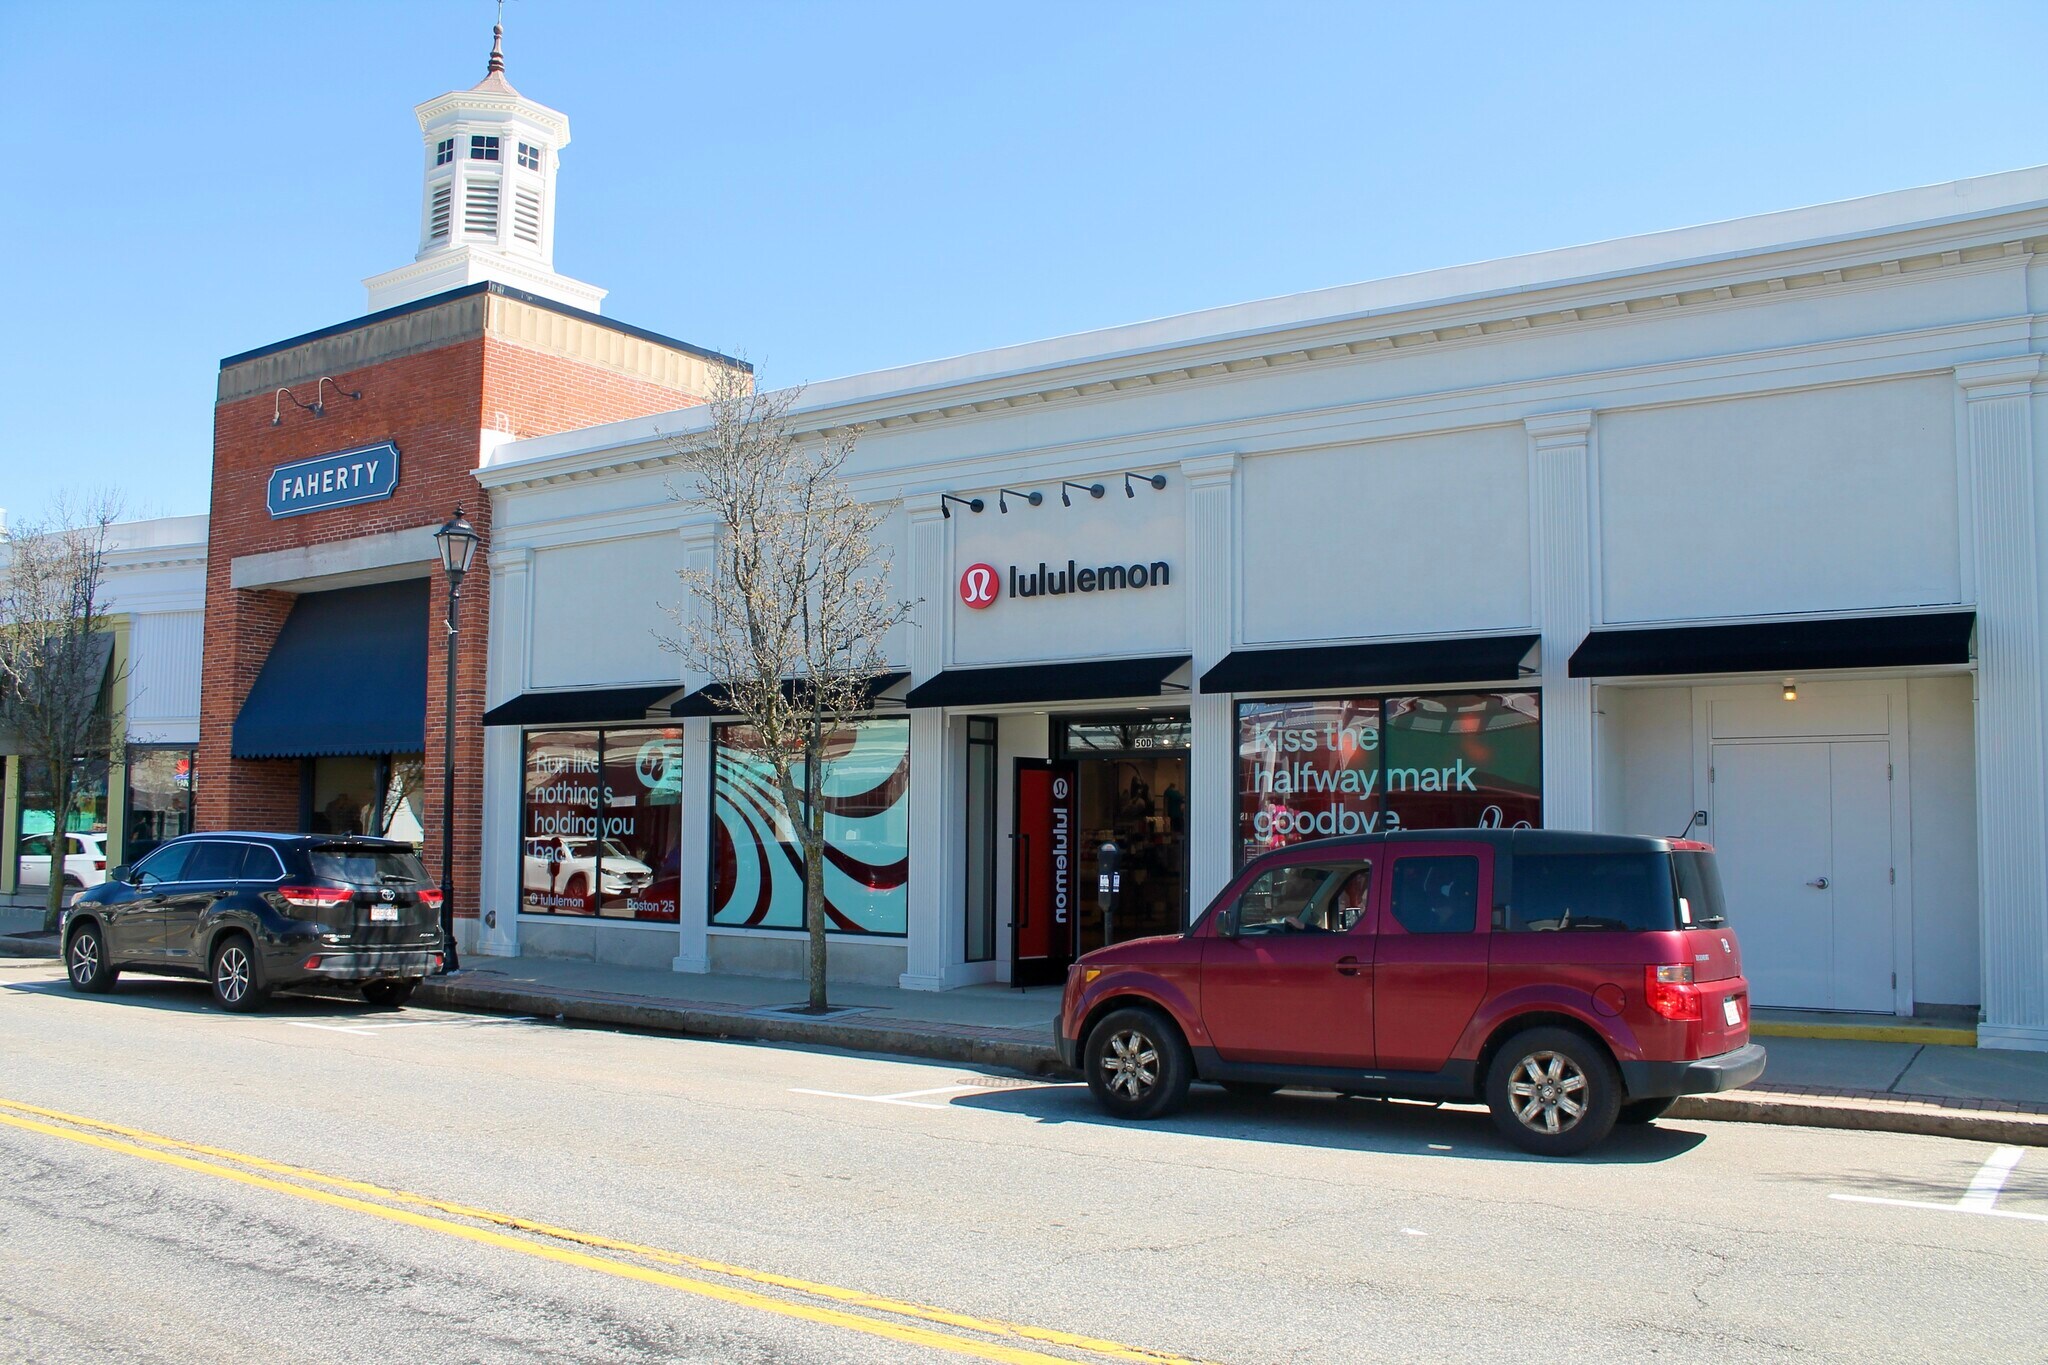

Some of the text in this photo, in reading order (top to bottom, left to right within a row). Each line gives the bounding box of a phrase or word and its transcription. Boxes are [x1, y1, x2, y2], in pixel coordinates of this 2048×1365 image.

[282, 460, 379, 501] FAHERTY
[1009, 559, 1170, 598] lululemon
[1255, 720, 1379, 752] Kiss the
[536, 749, 599, 774] Run like
[1254, 758, 1477, 800] halfway mark
[534, 810, 635, 838] holding you
[540, 895, 584, 908] lululemon
[626, 898, 675, 912] Boston '25
